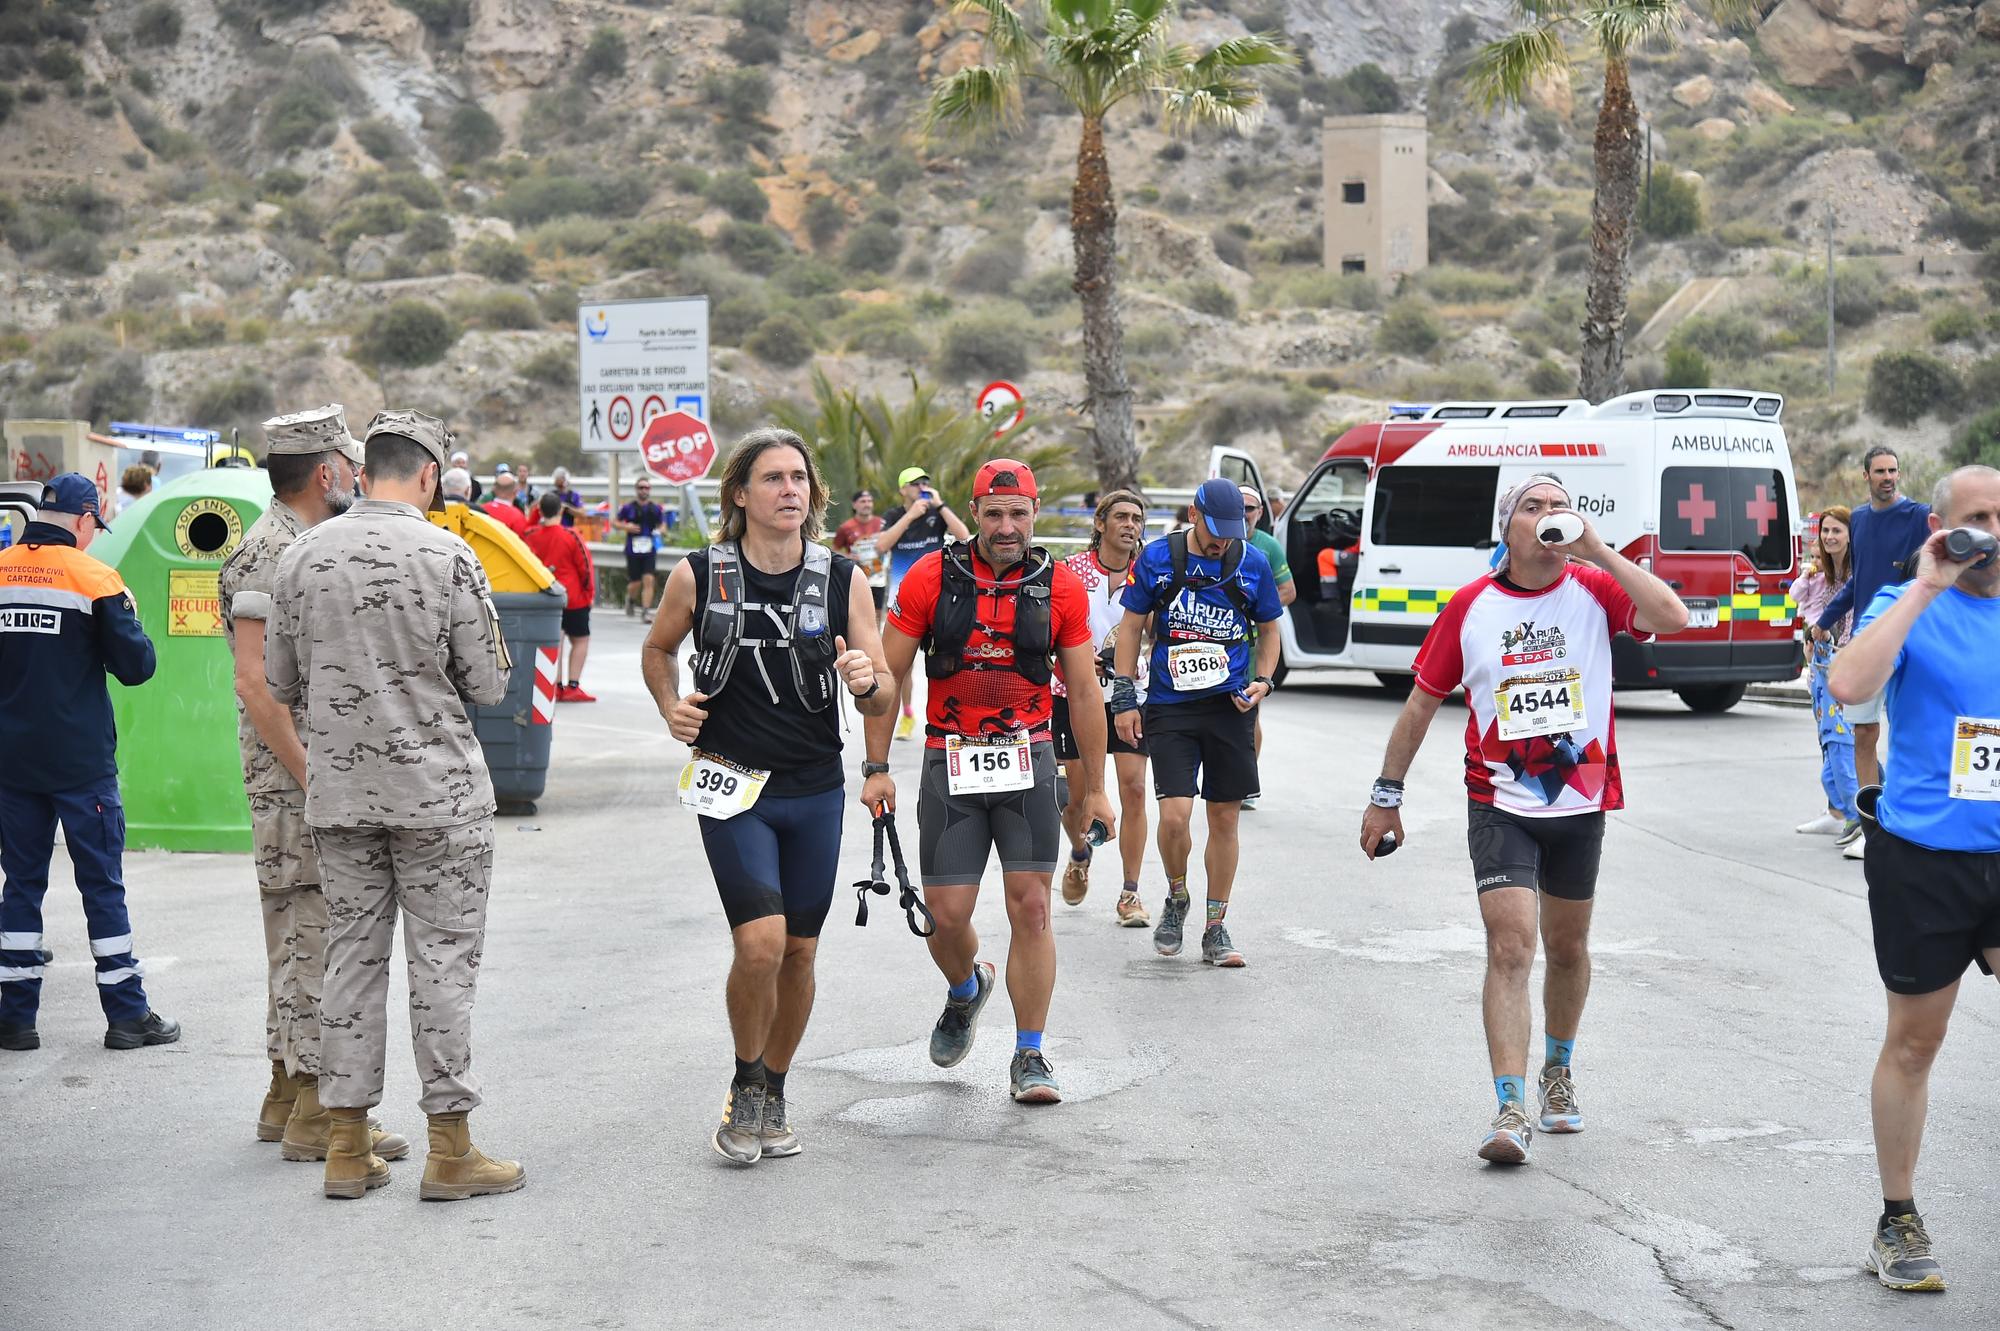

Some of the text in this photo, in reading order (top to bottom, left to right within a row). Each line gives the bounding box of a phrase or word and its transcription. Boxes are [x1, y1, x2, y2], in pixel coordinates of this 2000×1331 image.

[600, 366, 687, 377] CARRETERA DE SERVICIO
[667, 382, 705, 391] PORTUARIO
[613, 412, 628, 426] 40
[647, 432, 708, 462] STOP
[1447, 444, 1539, 457] AMBULANCIA
[1672, 435, 1775, 454] AMBULANCIA
[1577, 494, 1616, 517] Roja
[177, 500, 241, 535] SOLO ENVASES
[181, 543, 193, 559] DE
[7, 574, 53, 584] CARTAGENA
[46, 567, 65, 577] CIVIL
[1195, 602, 1234, 621] RUTA
[1168, 610, 1234, 630] FORTALEZAS
[1168, 621, 1212, 636] CARTAGENA
[1536, 626, 1561, 639] RUTA
[1522, 633, 1565, 647] FORTALEZAS
[1513, 652, 1552, 664] SPAR
[1178, 657, 1219, 675] 3368
[1544, 672, 1566, 682] 2023
[1509, 687, 1571, 714] 4544
[731, 761, 754, 776] 2023
[969, 751, 1011, 773] 156
[696, 768, 738, 797] 399
